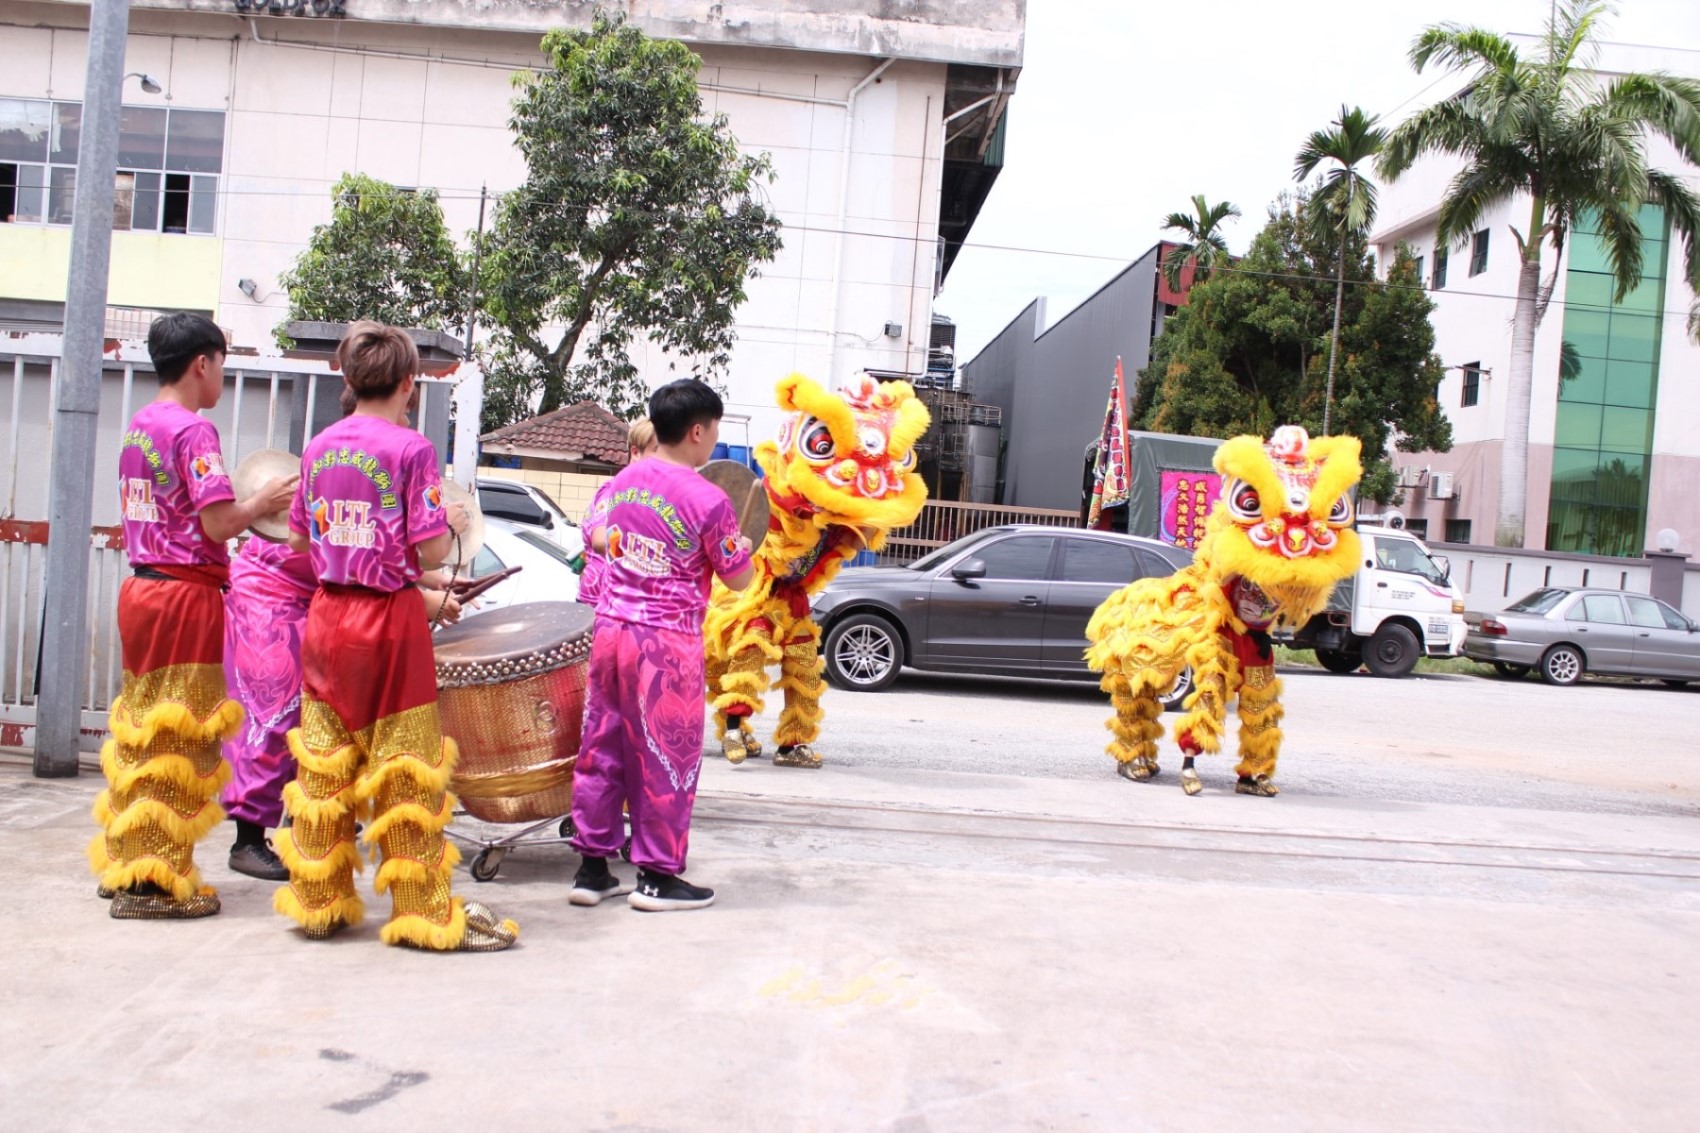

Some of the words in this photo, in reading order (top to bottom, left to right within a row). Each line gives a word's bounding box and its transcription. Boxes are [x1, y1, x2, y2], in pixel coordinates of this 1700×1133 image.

[332, 500, 377, 530] LTL
[329, 529, 376, 547] GROUP
[627, 533, 671, 563] LTL
